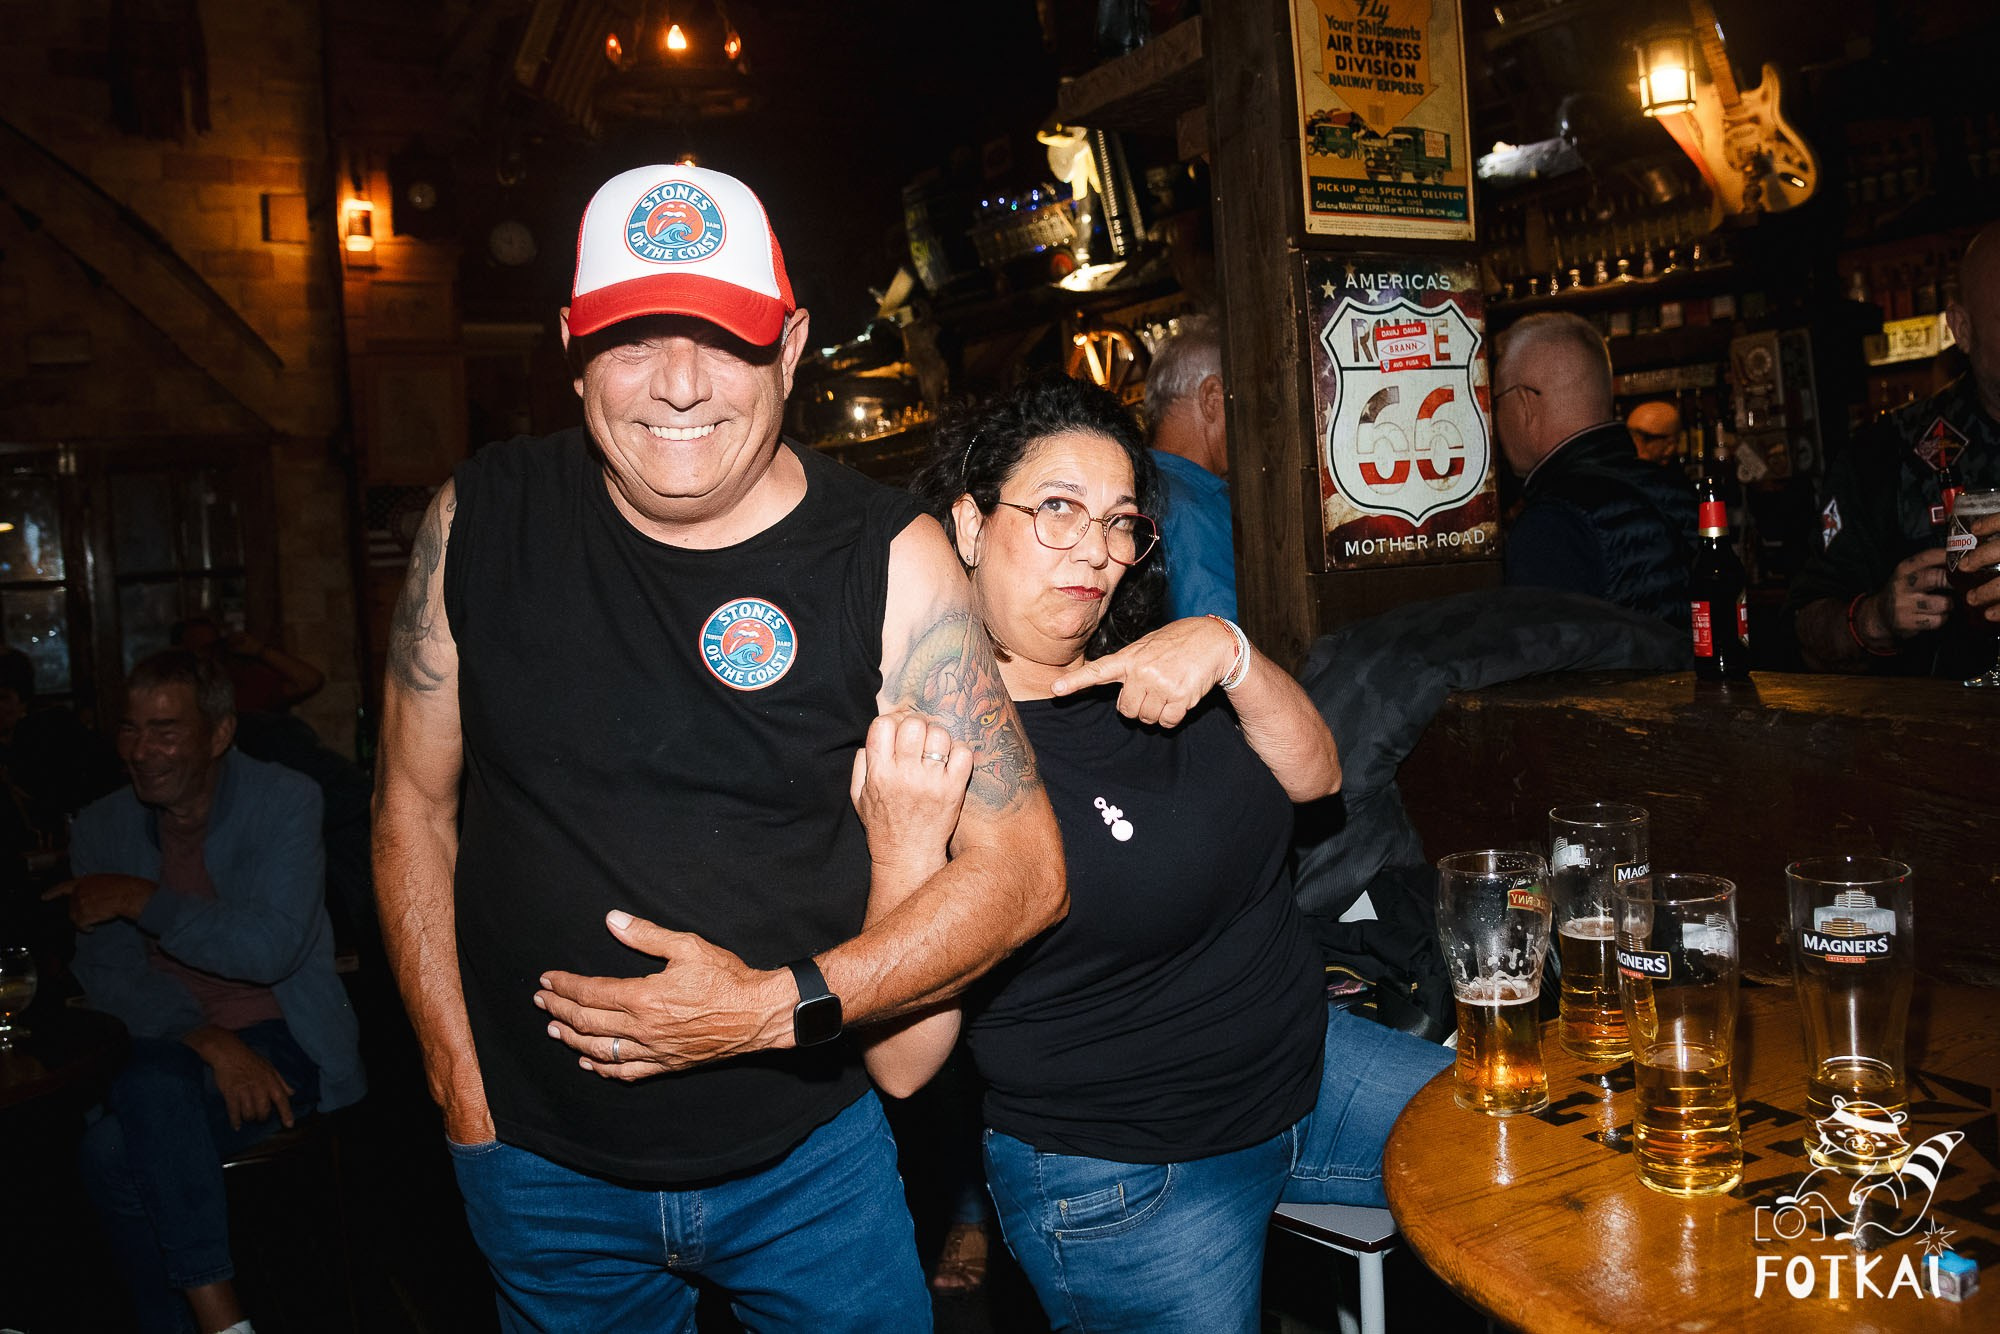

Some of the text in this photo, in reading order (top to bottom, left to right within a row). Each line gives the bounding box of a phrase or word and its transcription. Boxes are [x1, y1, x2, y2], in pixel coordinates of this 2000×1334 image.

[1325, 14, 1421, 40] Your Shipments
[1327, 34, 1421, 60] AIR EXPRESS
[1335, 55, 1416, 79] DIVISION
[1329, 73, 1424, 95] RAILWAY EXPRESS
[640, 185, 712, 211] STONES
[1379, 187, 1418, 197] SPECIAL
[1422, 190, 1464, 200] DELIVERY
[630, 232, 720, 260] OF THE COAST
[1345, 273, 1451, 291] AMERICA'S
[1389, 342, 1418, 353] BRANN
[1356, 385, 1465, 496] 66
[1345, 529, 1486, 557] MOTHER ROAD
[718, 603, 785, 630] STONES
[705, 644, 787, 684] OF THE COAST
[1803, 933, 1889, 953] MAGNERS
[1616, 950, 1667, 973] AGNERS
